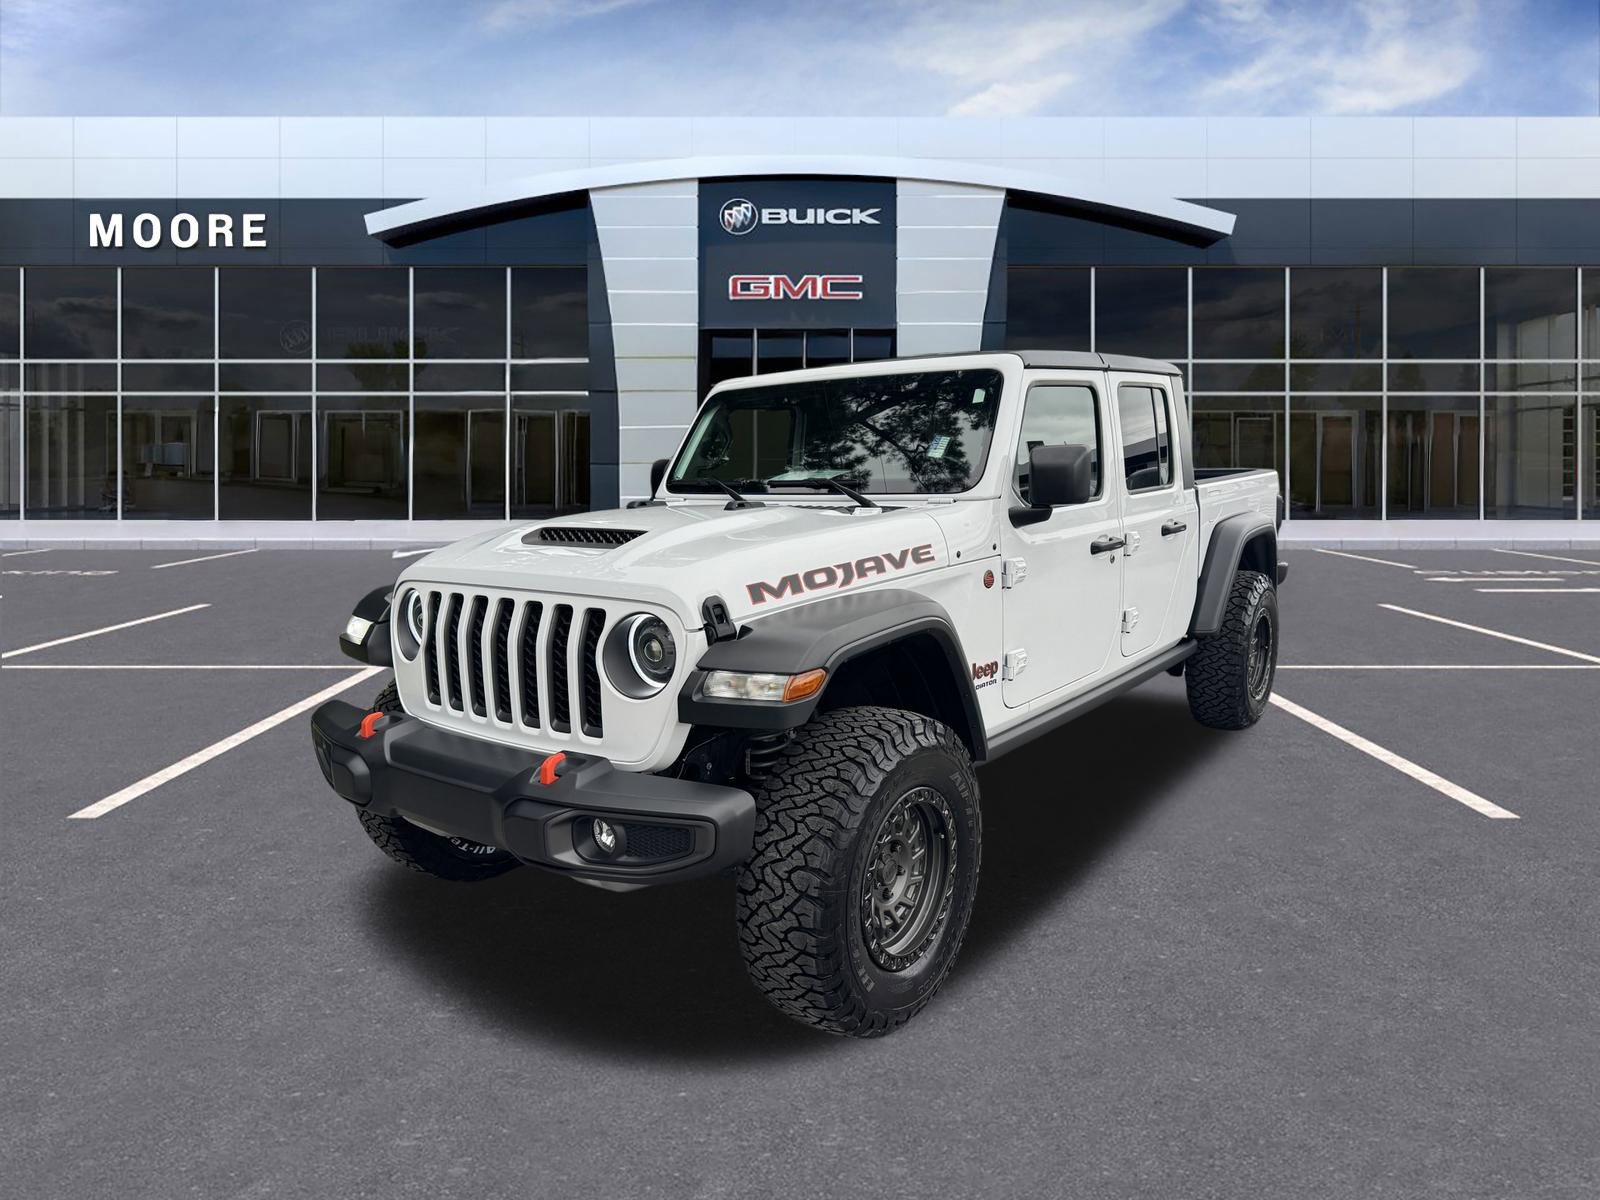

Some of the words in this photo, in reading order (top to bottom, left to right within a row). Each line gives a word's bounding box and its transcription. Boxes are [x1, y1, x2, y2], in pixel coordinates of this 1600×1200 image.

[761, 208, 881, 225] BUICK
[89, 213, 267, 248] MOORE
[728, 275, 863, 300] GMC
[745, 543, 935, 605] MOJAVE
[448, 836, 496, 854] All-Te
